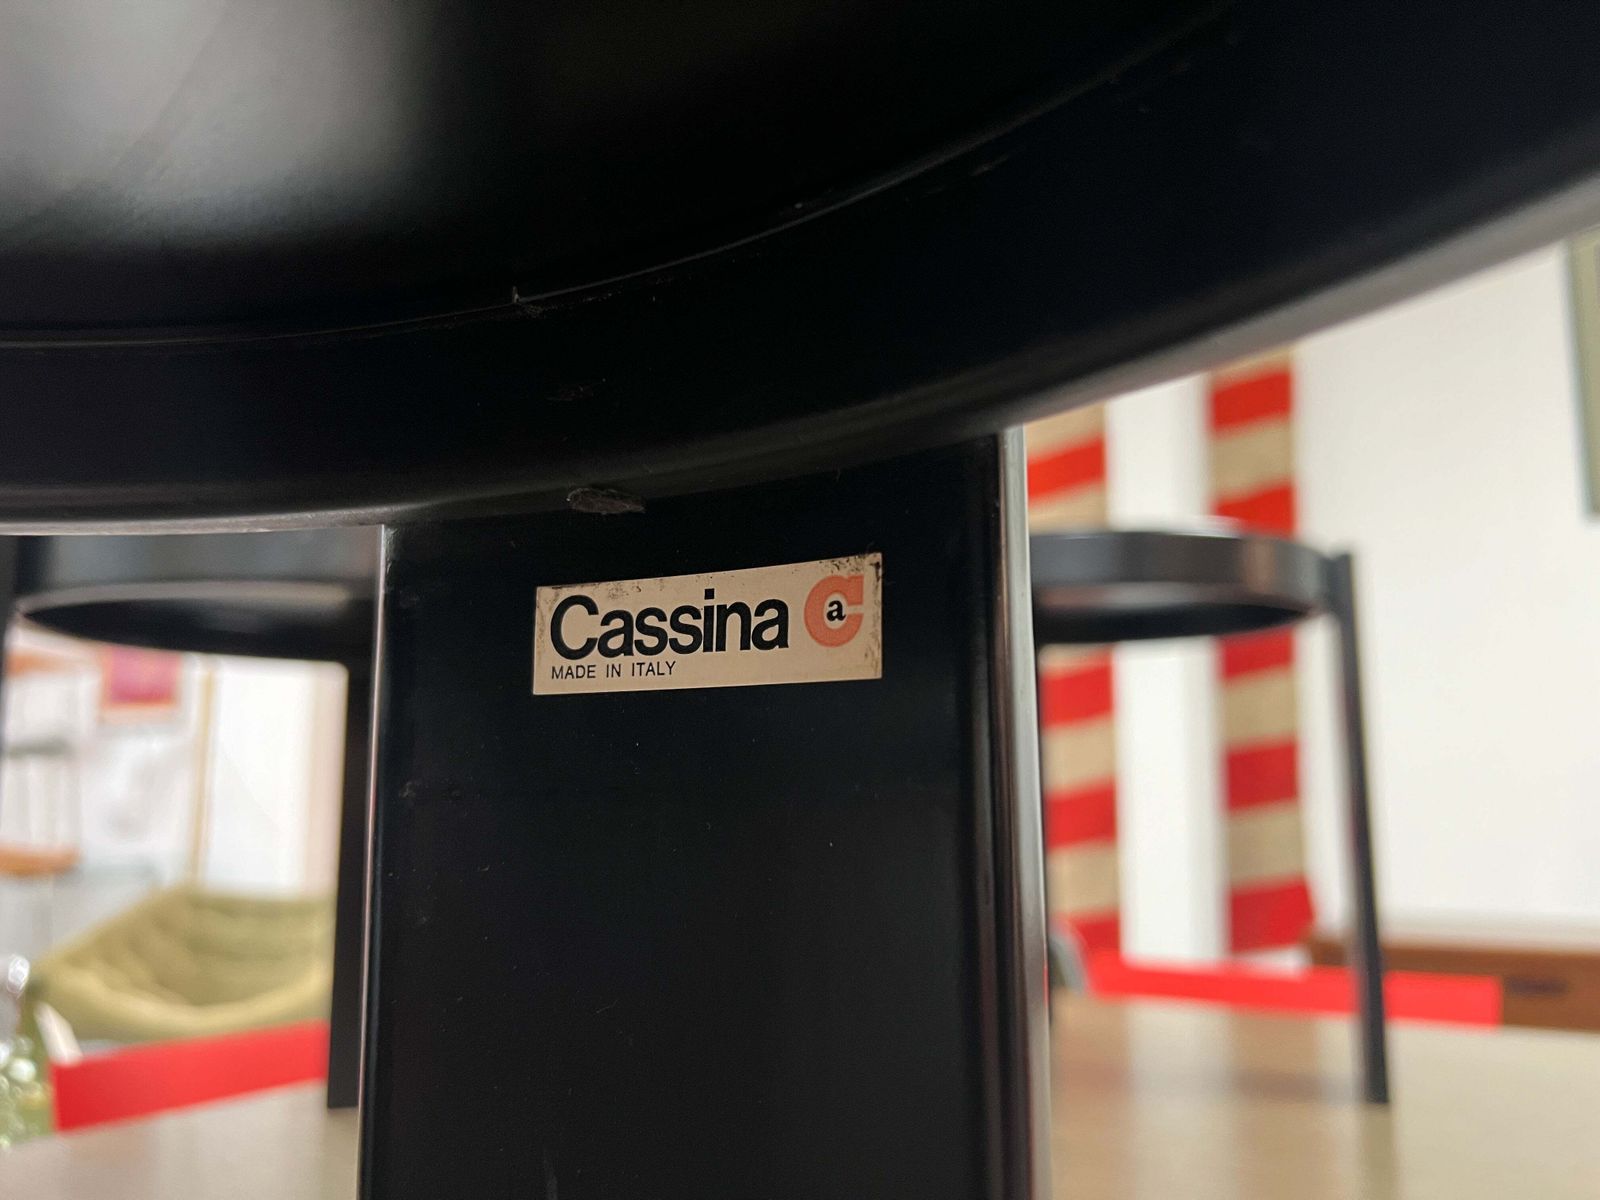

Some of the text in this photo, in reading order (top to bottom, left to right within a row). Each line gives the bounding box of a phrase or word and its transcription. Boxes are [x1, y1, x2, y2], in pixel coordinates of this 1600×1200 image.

[551, 588, 789, 660] Cassina
[551, 661, 676, 679] MADE IN ITALY
